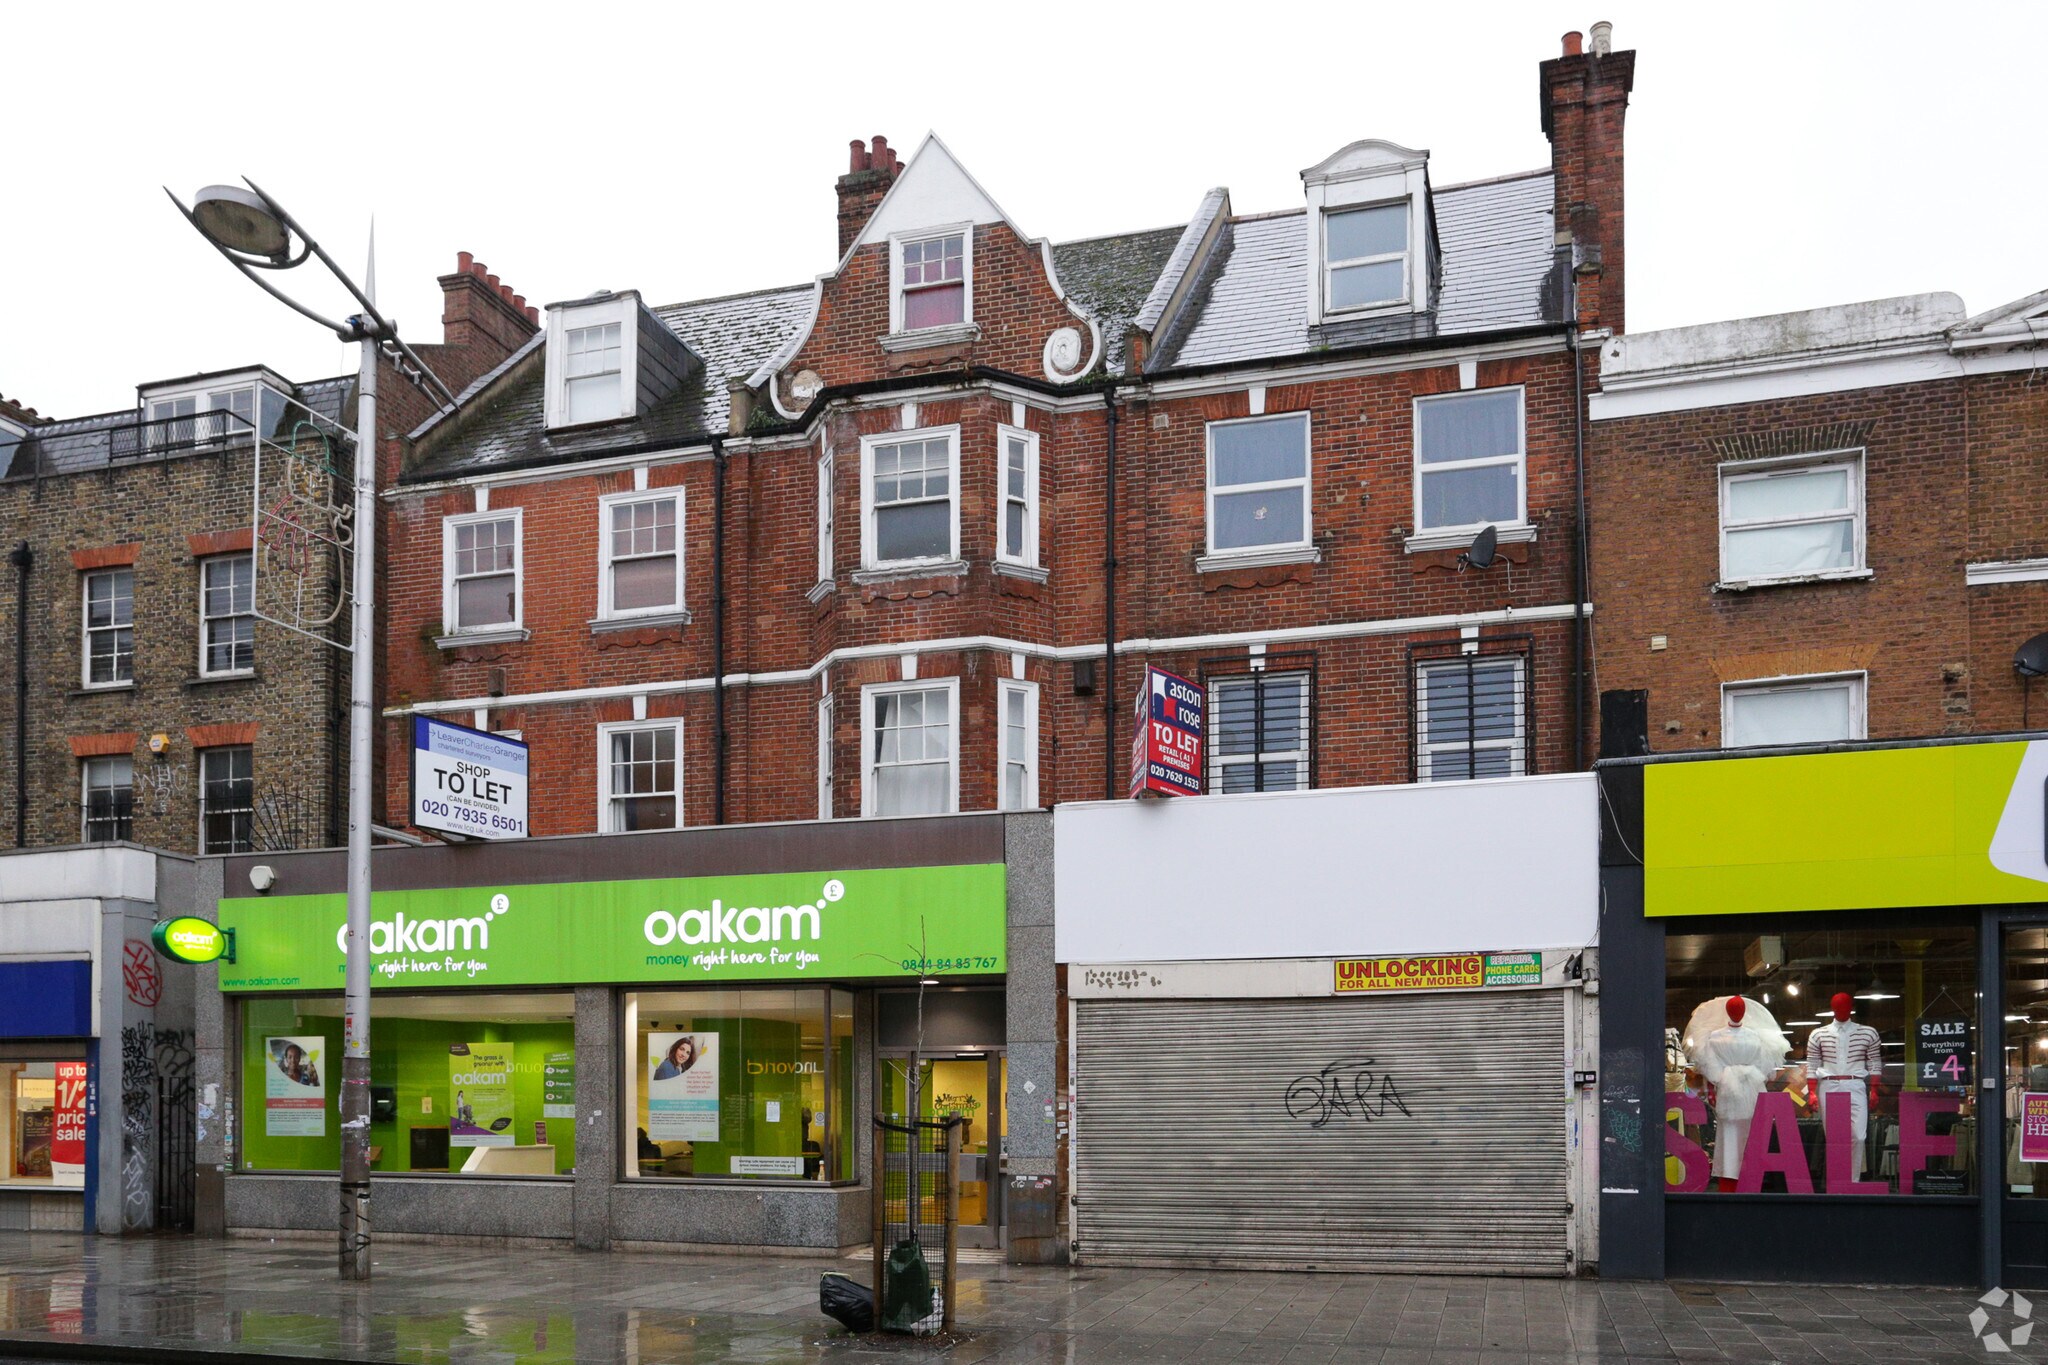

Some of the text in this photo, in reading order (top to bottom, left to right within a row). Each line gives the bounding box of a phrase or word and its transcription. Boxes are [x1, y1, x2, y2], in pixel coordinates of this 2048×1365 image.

[1170, 682, 1201, 708] aston
[1178, 706, 1200, 729] rose
[437, 730, 525, 761] LeaverCharlesGranger
[1153, 722, 1198, 754] TO LET
[438, 742, 491, 761] chartered surveyors
[1159, 744, 1179, 758] RETAIL
[456, 761, 490, 778] SHOP
[1163, 754, 1190, 770] PREMISES
[1150, 764, 1164, 778] 020
[1166, 769, 1183, 784] 7629
[1184, 776, 1199, 790] 1533
[434, 768, 512, 805] TO LET
[446, 795, 500, 813] (CAN BE DIVIDED)
[422, 799, 523, 833] 020 7935 6501
[446, 821, 500, 837] www.lcg.uk.com
[644, 898, 820, 946] oakam
[172, 931, 214, 945] oakam
[378, 956, 409, 978] right
[411, 958, 441, 973] here
[444, 957, 465, 971] for
[467, 958, 488, 978] you
[646, 948, 820, 972] money right here for you
[902, 956, 997, 970] 0844 84 85 767
[1490, 954, 1535, 965] REPAIRING,
[1339, 958, 1480, 979] UNLOCKING
[1486, 964, 1540, 974] PHONE CARDS
[222, 976, 300, 987] www.oakam.com
[1340, 976, 1478, 989] FOR ALL NEW MODELS
[1486, 974, 1540, 985] ACCESSORIES
[1921, 1022, 1966, 1036] SALE
[1922, 1041, 1965, 1049] Everything
[1934, 1046, 1954, 1054] from
[60, 1064, 86, 1078] up to
[452, 1070, 506, 1085] oakam
[942, 1093, 968, 1102] Merry
[26, 1116, 34, 1128] 3
[44, 1116, 51, 1127] 2
[58, 1110, 86, 1127] pric
[56, 1126, 86, 1141] sale
[1665, 1092, 1960, 1194] SALE
